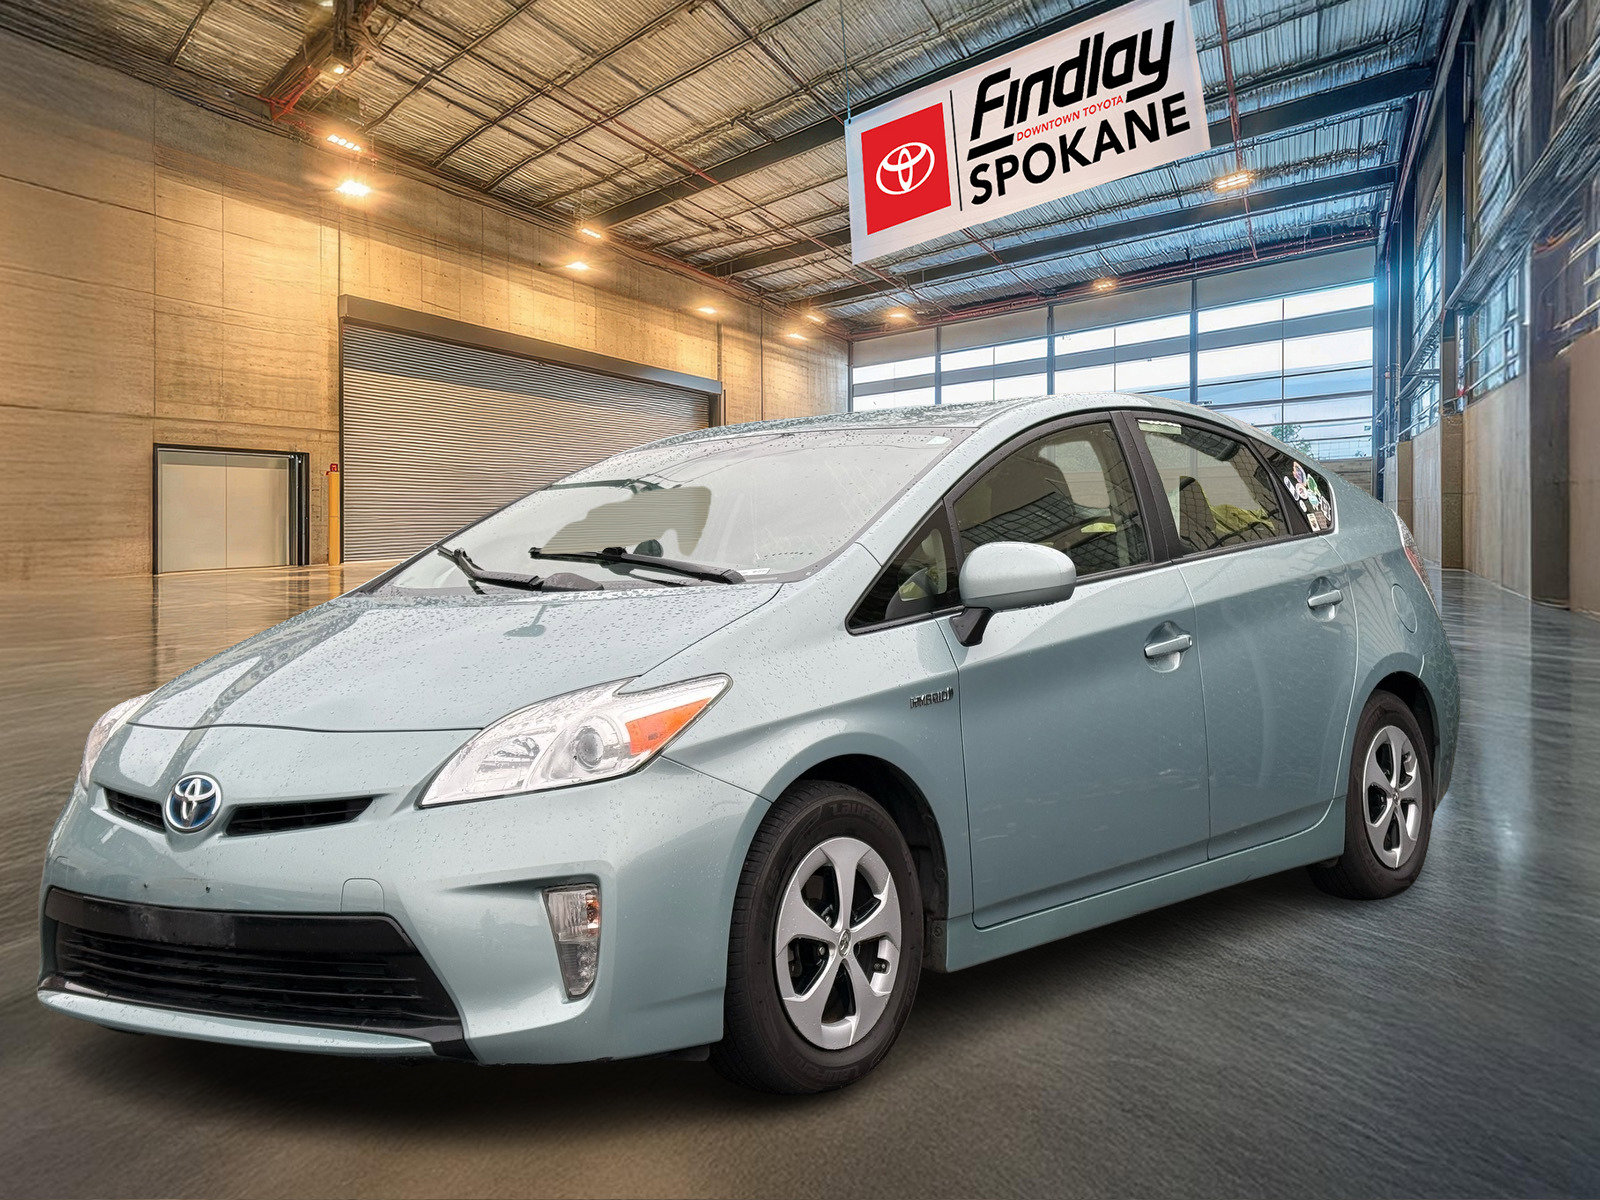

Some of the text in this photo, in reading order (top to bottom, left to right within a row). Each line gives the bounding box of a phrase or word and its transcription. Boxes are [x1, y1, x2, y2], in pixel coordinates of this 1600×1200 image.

[970, 20, 1175, 142] Findlay
[1016, 94, 1124, 142] DOWNTOWN TOYOTA
[970, 91, 1191, 205] SPOKANE
